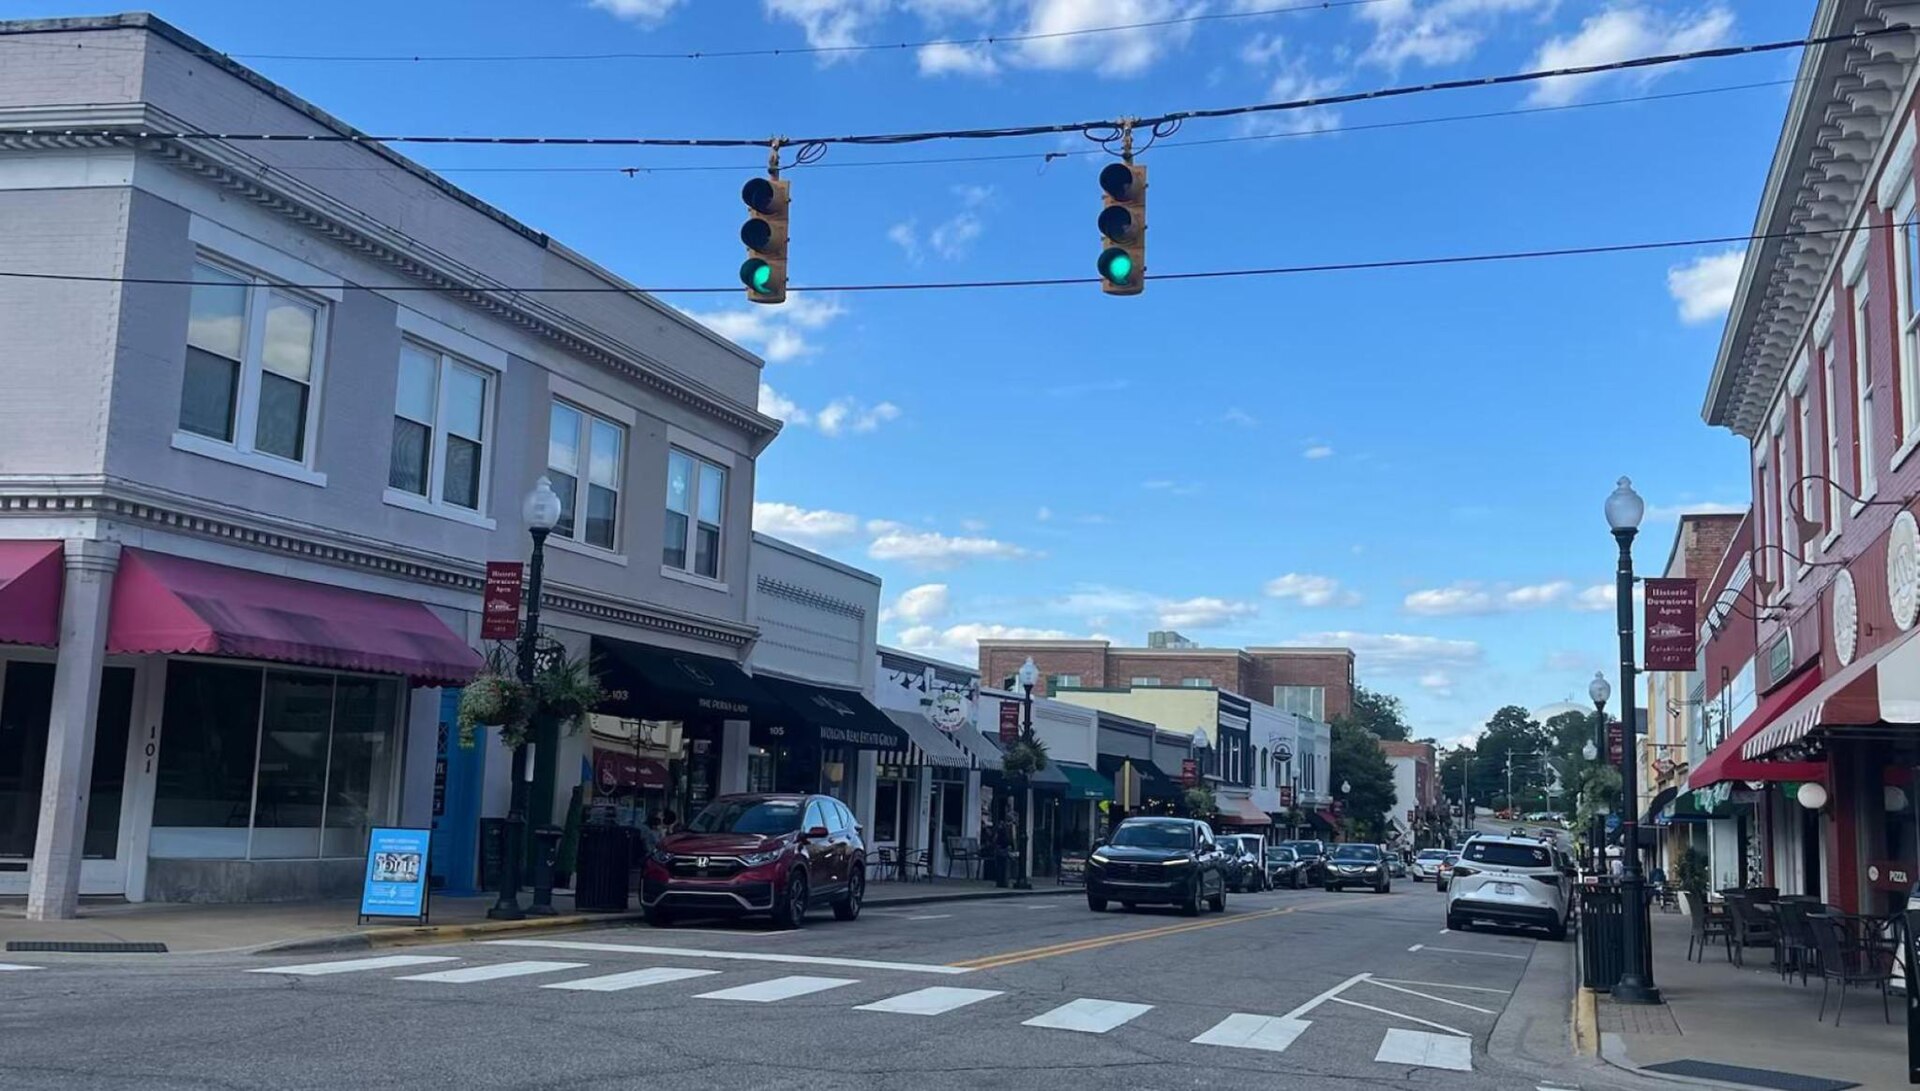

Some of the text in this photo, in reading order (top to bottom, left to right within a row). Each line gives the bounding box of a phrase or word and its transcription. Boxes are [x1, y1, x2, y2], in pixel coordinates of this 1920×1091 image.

[491, 570, 518, 578] Historic
[1652, 588, 1689, 597] Historic
[1646, 598, 1694, 606] Downtown
[1659, 606, 1682, 616] Apex
[769, 726, 785, 736] 105
[1889, 870, 1908, 883] PIZZA
